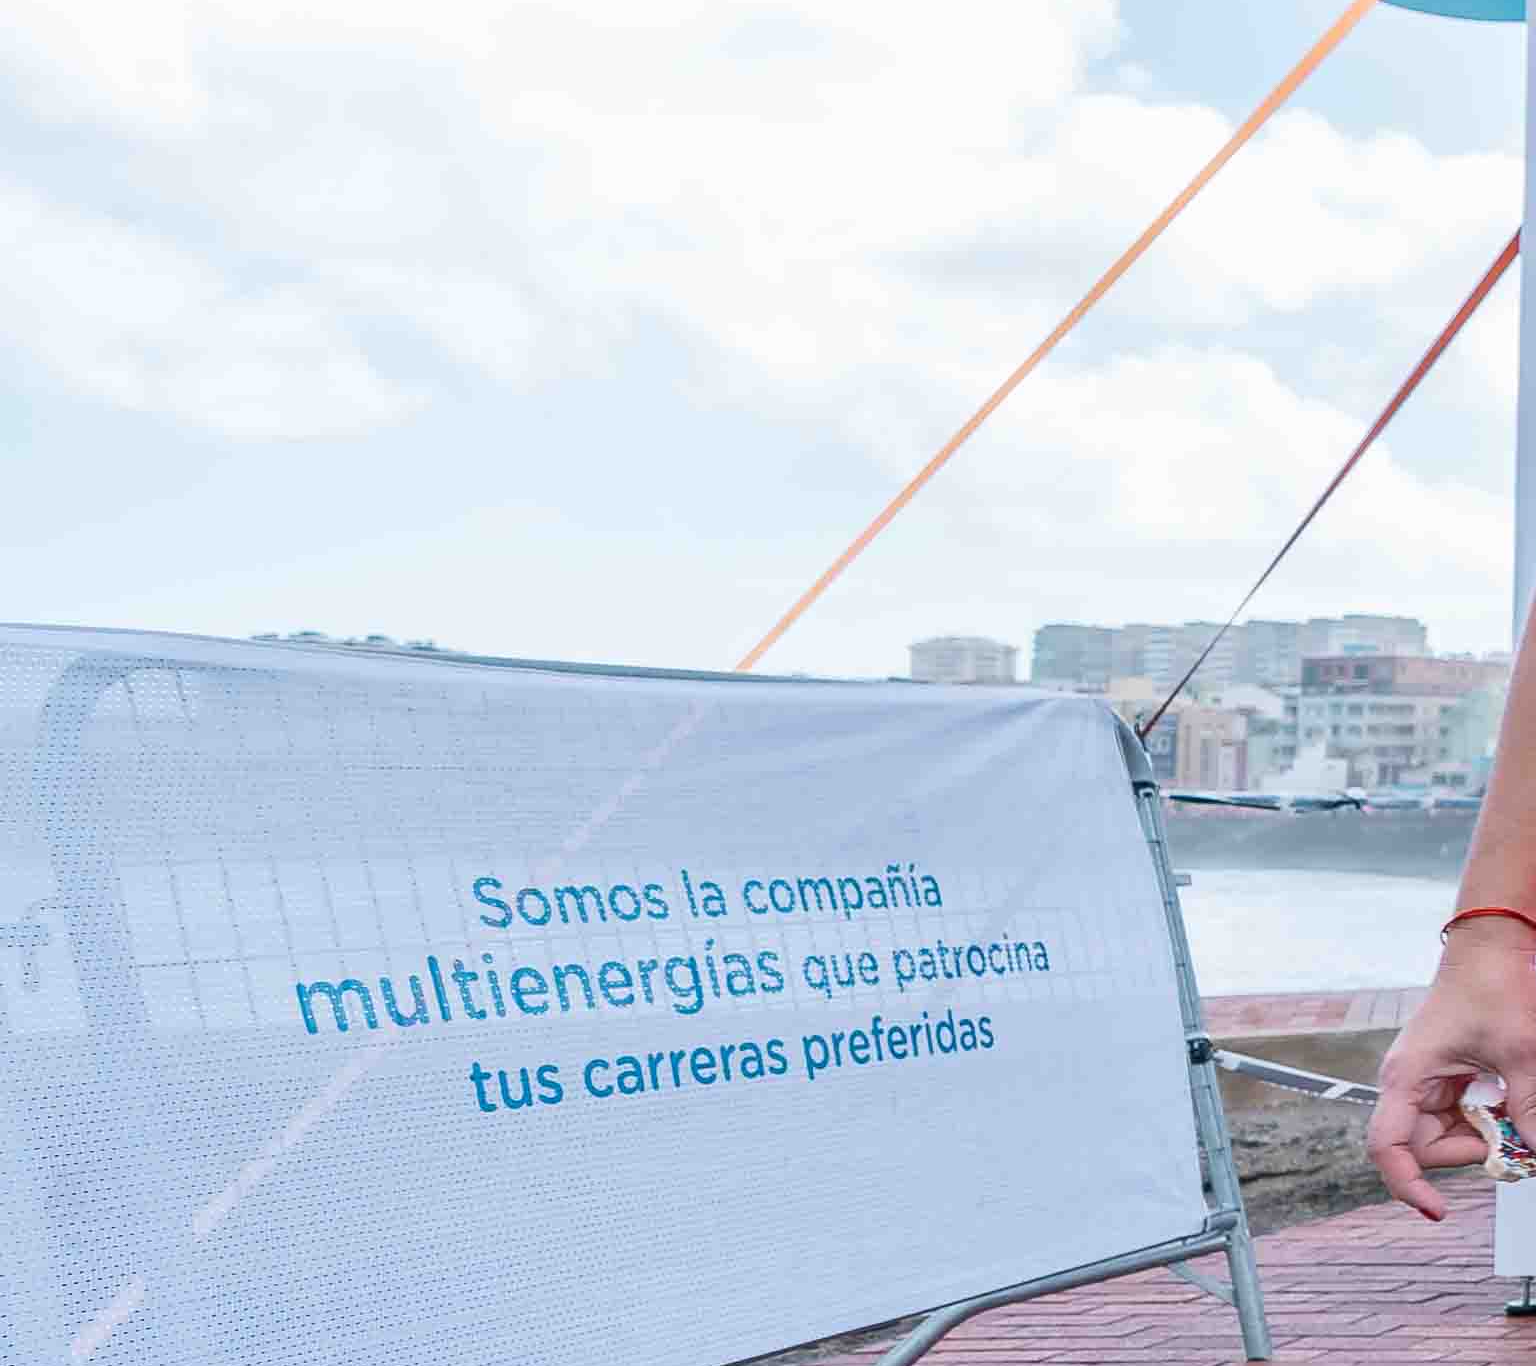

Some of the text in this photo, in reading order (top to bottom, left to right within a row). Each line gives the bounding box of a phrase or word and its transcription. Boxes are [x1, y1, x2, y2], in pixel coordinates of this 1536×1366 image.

[469, 860, 943, 932] Somos la compañía
[294, 931, 1050, 1036] multienergías que patrocina
[468, 1007, 996, 1113] tus carreras preferidas
